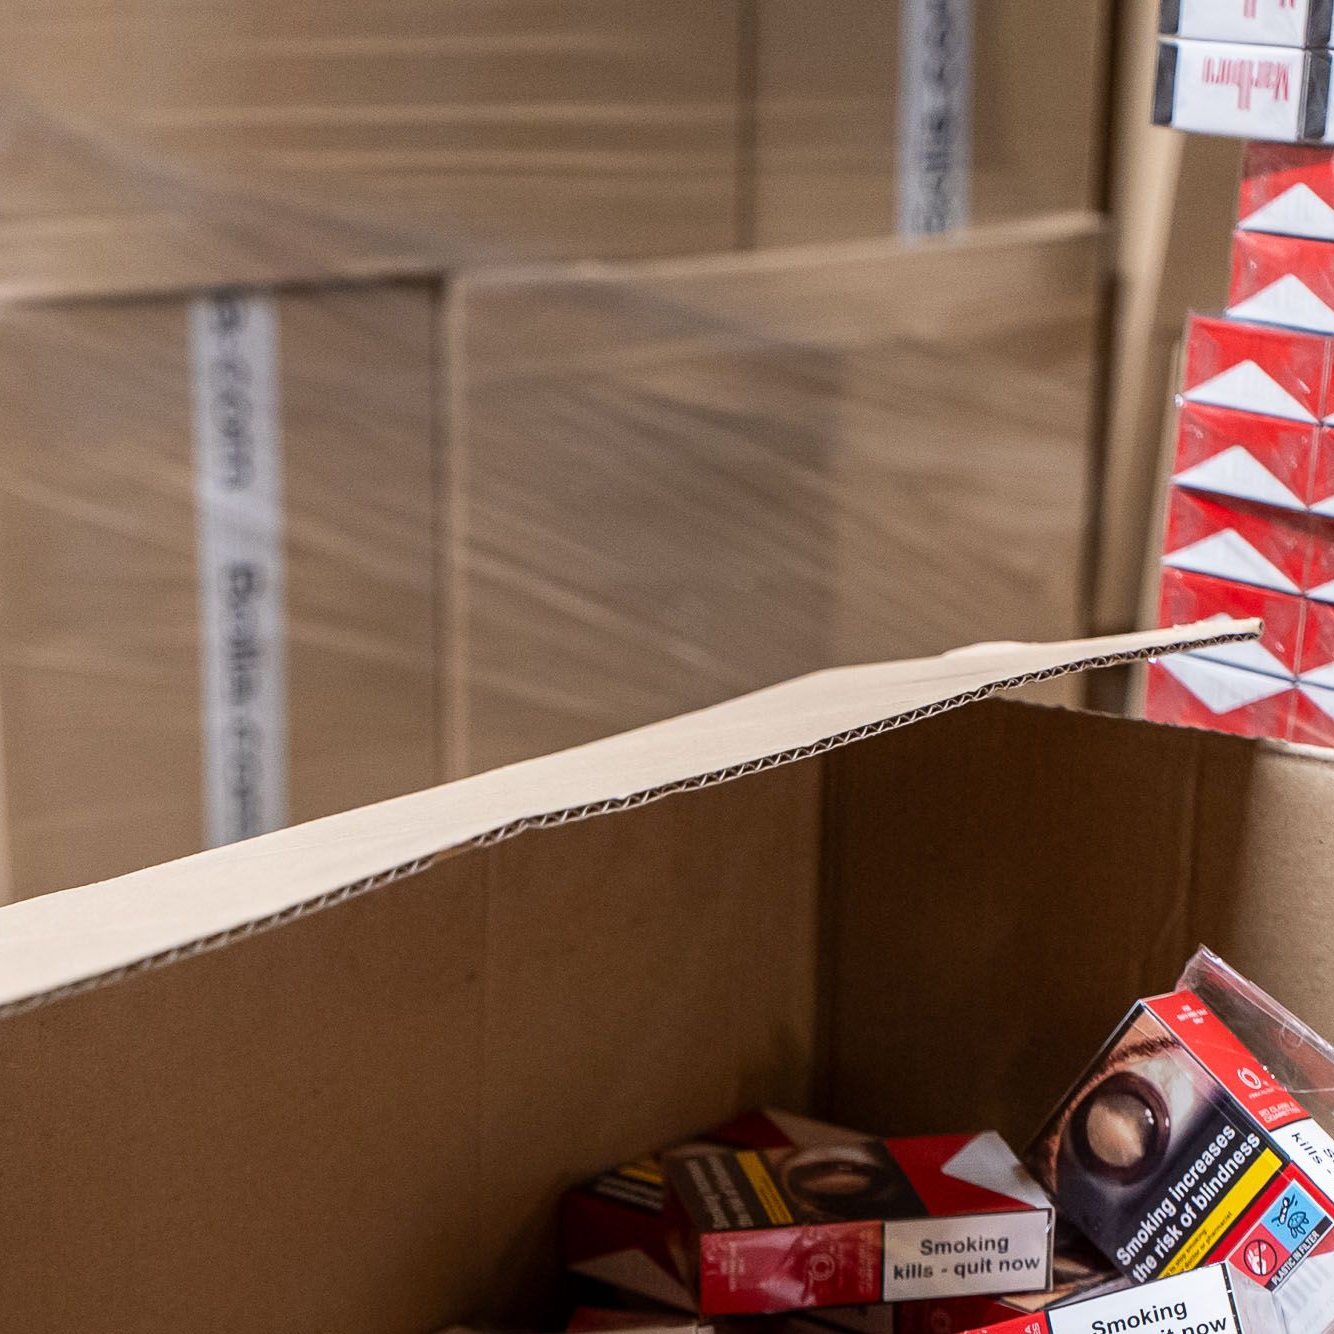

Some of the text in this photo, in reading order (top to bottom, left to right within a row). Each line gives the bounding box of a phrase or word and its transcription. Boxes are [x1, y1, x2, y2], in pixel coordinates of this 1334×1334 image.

[1292, 1131, 1324, 1173] kills
[1116, 1124, 1236, 1267] Smoking increases
[1132, 1132, 1261, 1282] the risk of blindness
[893, 1254, 1040, 1281] kills quit now
[920, 1236, 1009, 1257] Smoking
[1271, 1230, 1320, 1285] PLASTIC FILTER
